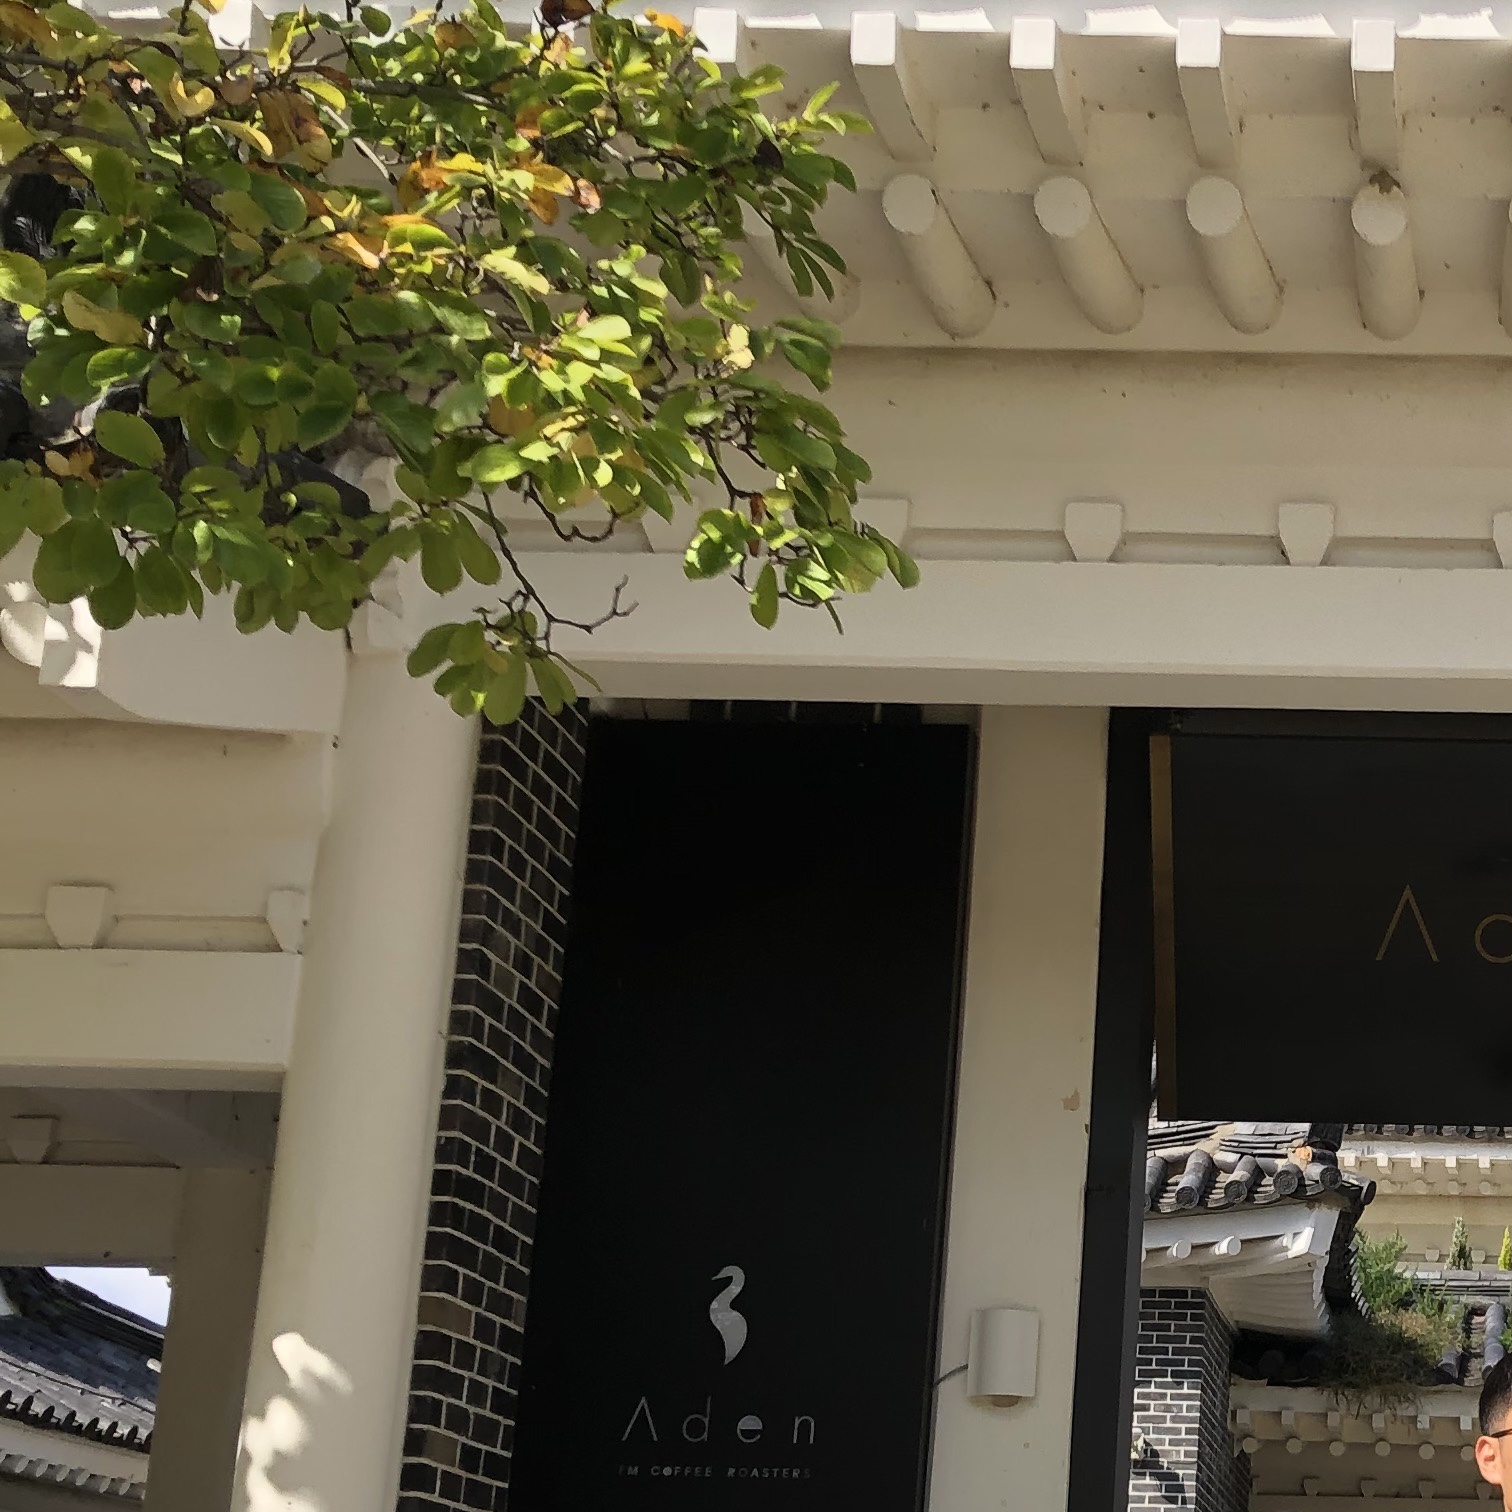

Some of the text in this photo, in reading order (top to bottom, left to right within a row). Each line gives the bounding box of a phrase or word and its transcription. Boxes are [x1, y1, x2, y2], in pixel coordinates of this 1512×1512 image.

[621, 1396, 815, 1444] Aden
[650, 1465, 711, 1477] COFFEE
[726, 1466, 812, 1479] ROASTERS
